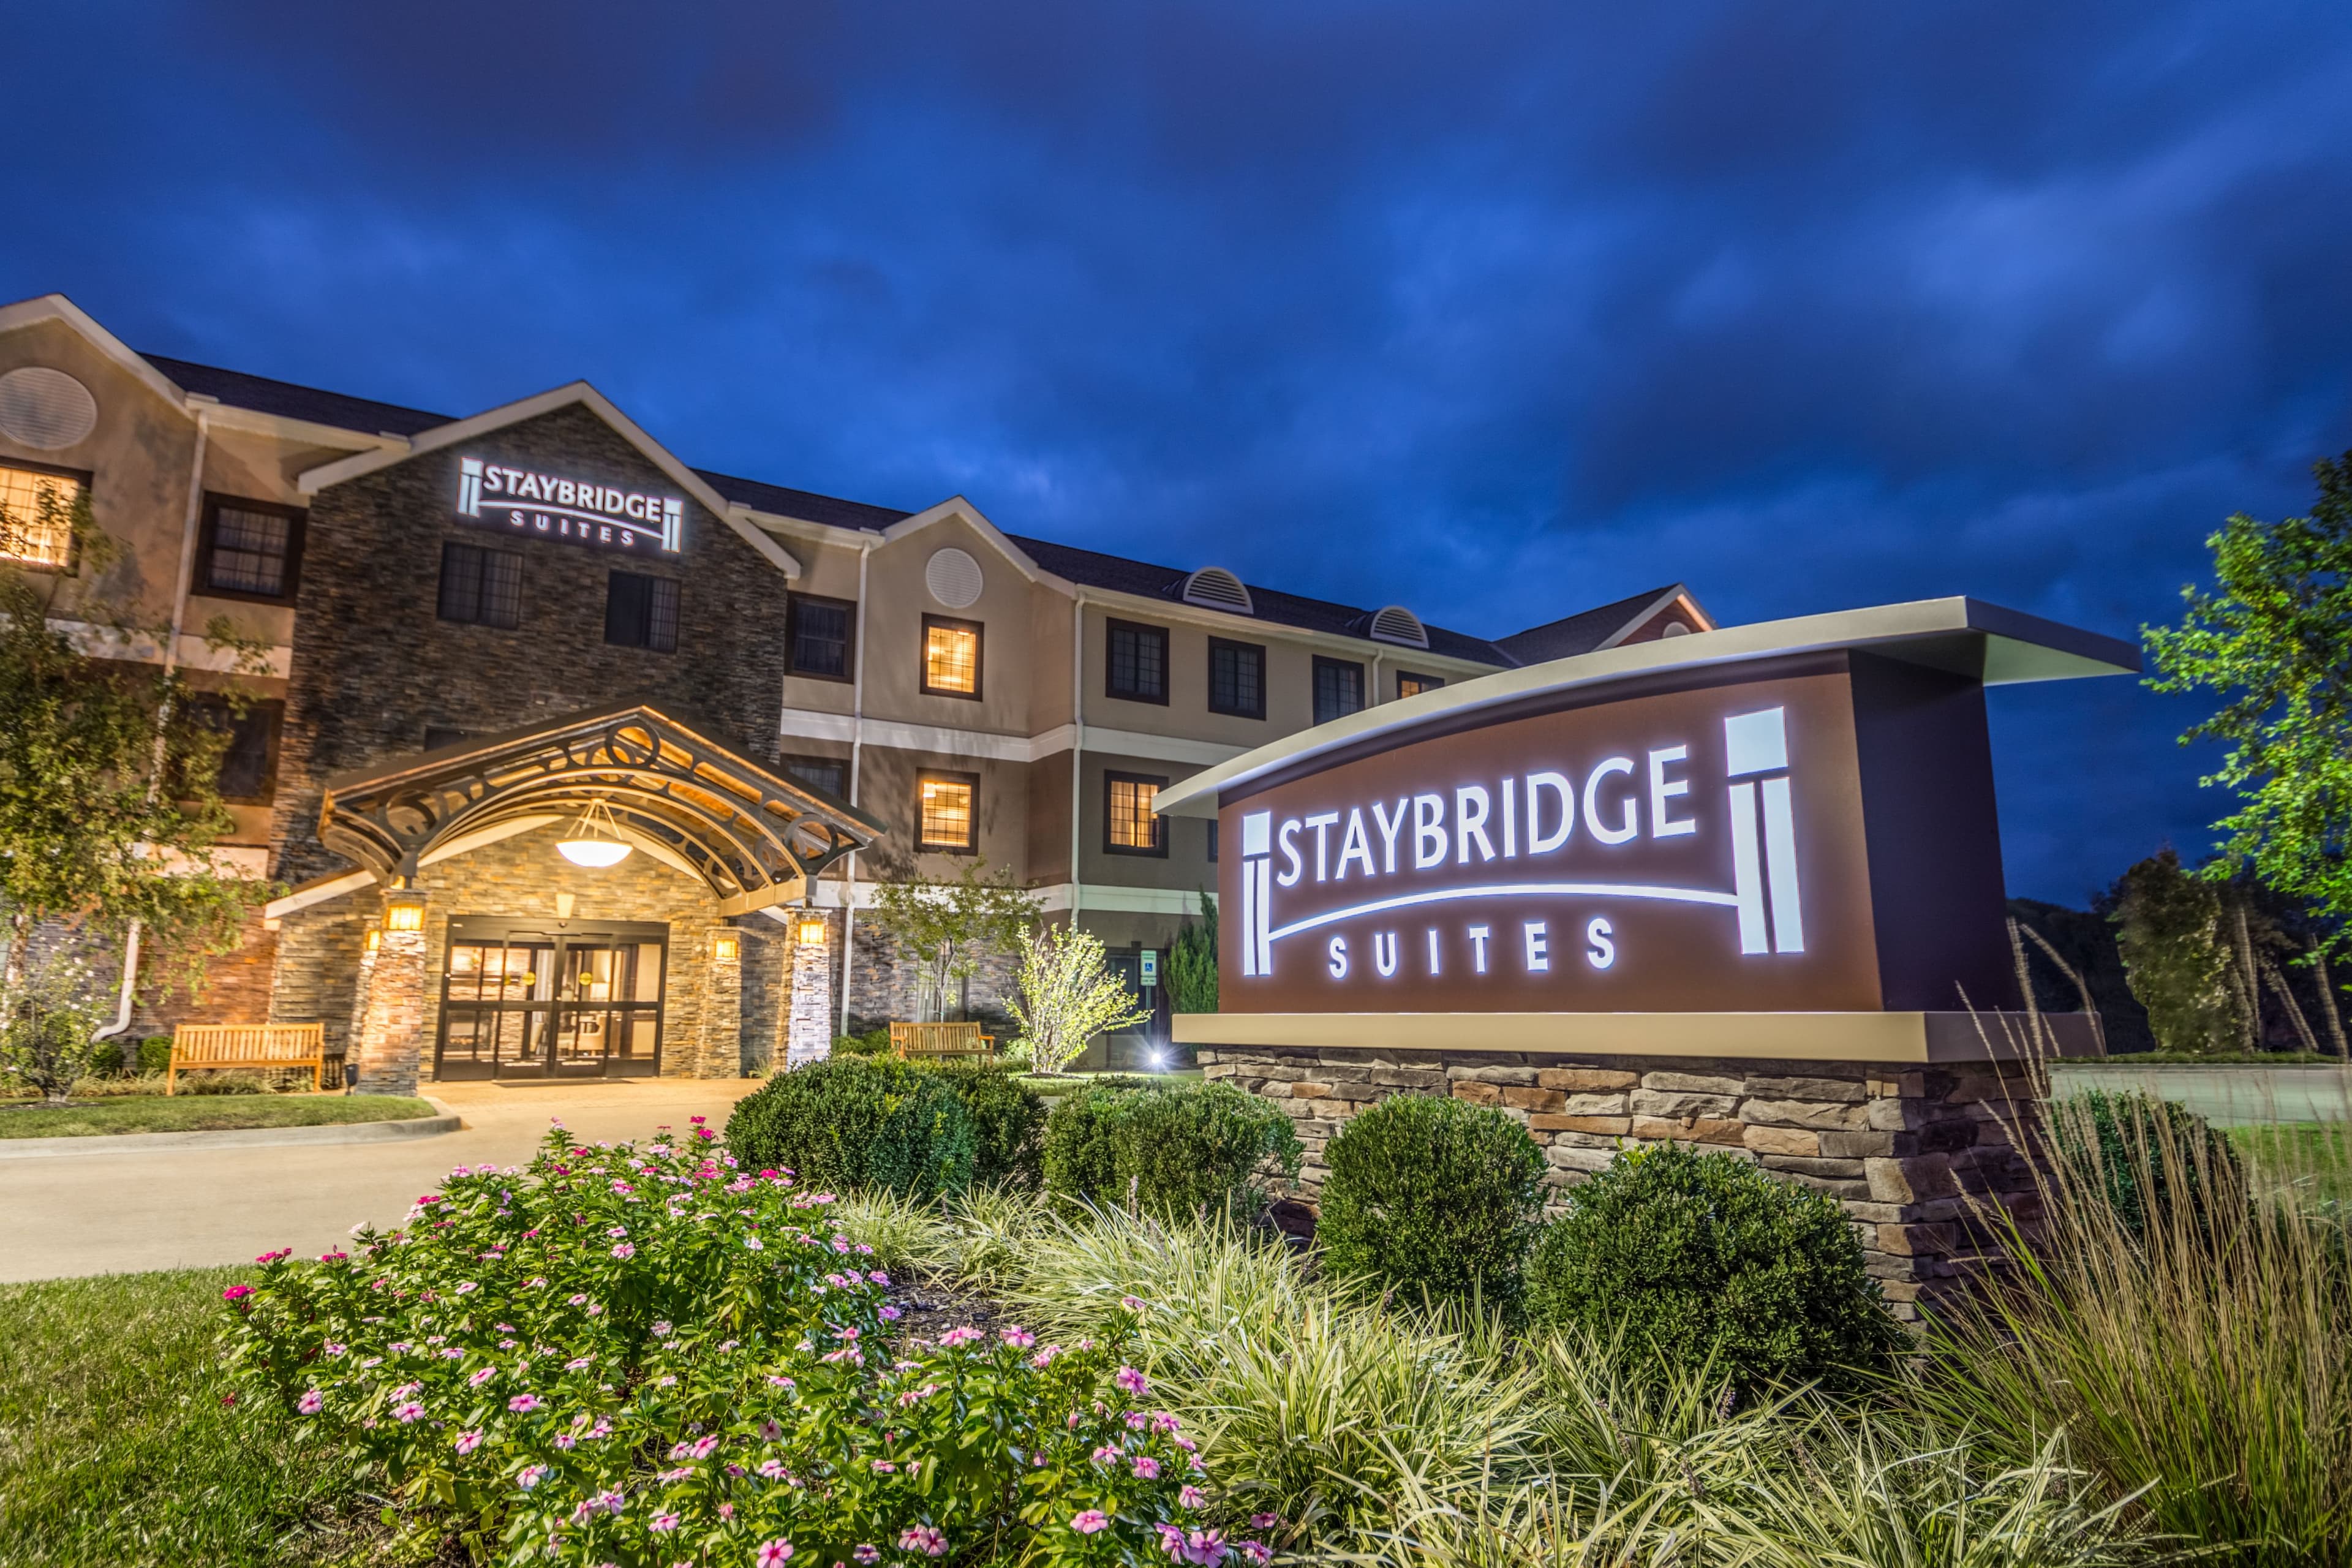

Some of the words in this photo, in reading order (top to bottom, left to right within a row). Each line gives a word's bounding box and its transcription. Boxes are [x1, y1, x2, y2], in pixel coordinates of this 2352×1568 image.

[483, 464, 662, 522] STAYBRIDGE
[510, 510, 635, 546] SUITES
[1276, 744, 1697, 888] STAYBRIDGE
[1328, 918, 1615, 979] SUITES
